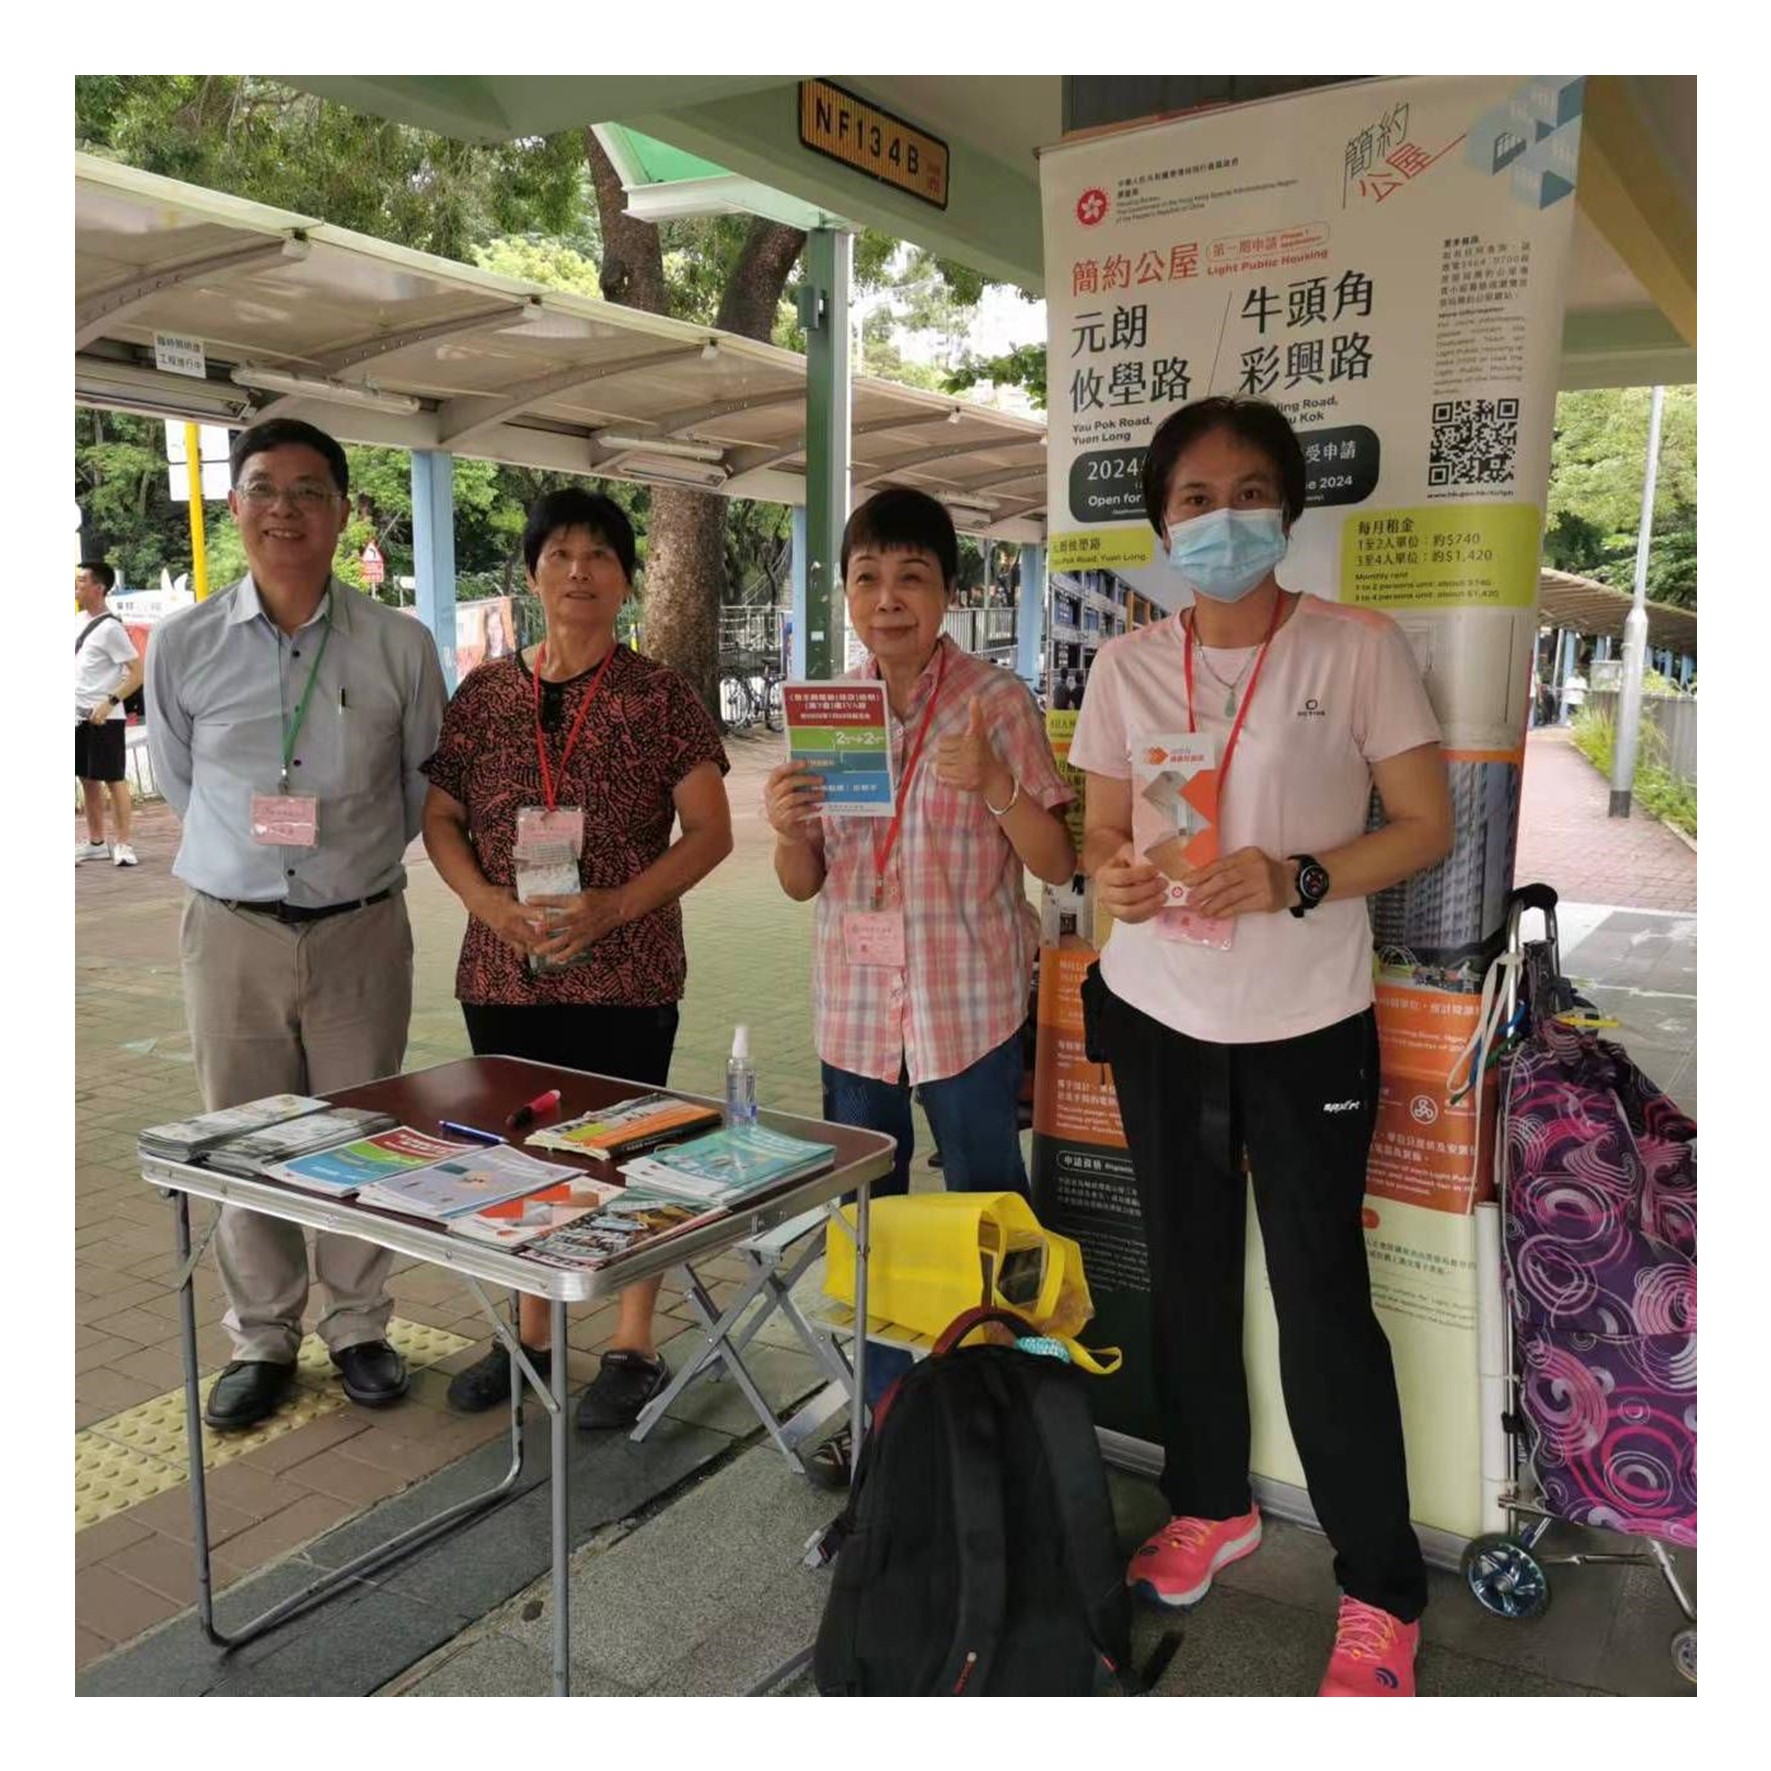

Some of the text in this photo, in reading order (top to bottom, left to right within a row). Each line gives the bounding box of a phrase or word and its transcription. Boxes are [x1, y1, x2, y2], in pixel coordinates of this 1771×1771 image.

[815, 98, 919, 174] NF134B
[1072, 242, 1200, 298] 簡約公屋
[1206, 248, 1329, 278] Light Public Housing
[1240, 268, 1374, 334] 牛頭角
[1070, 304, 1149, 359] 元朗
[1239, 331, 1374, 396] 彩興路
[1069, 356, 1193, 414] 攸壆路
[1072, 424, 1092, 433] Yau
[1094, 419, 1117, 431] Pok
[1299, 411, 1325, 424] Kok
[1072, 432, 1131, 445] Yuen Long
[1087, 456, 1146, 481] 2024
[1319, 474, 1354, 490] 2024
[1087, 492, 1142, 508] Open for
[1358, 517, 1415, 536] 每月租金
